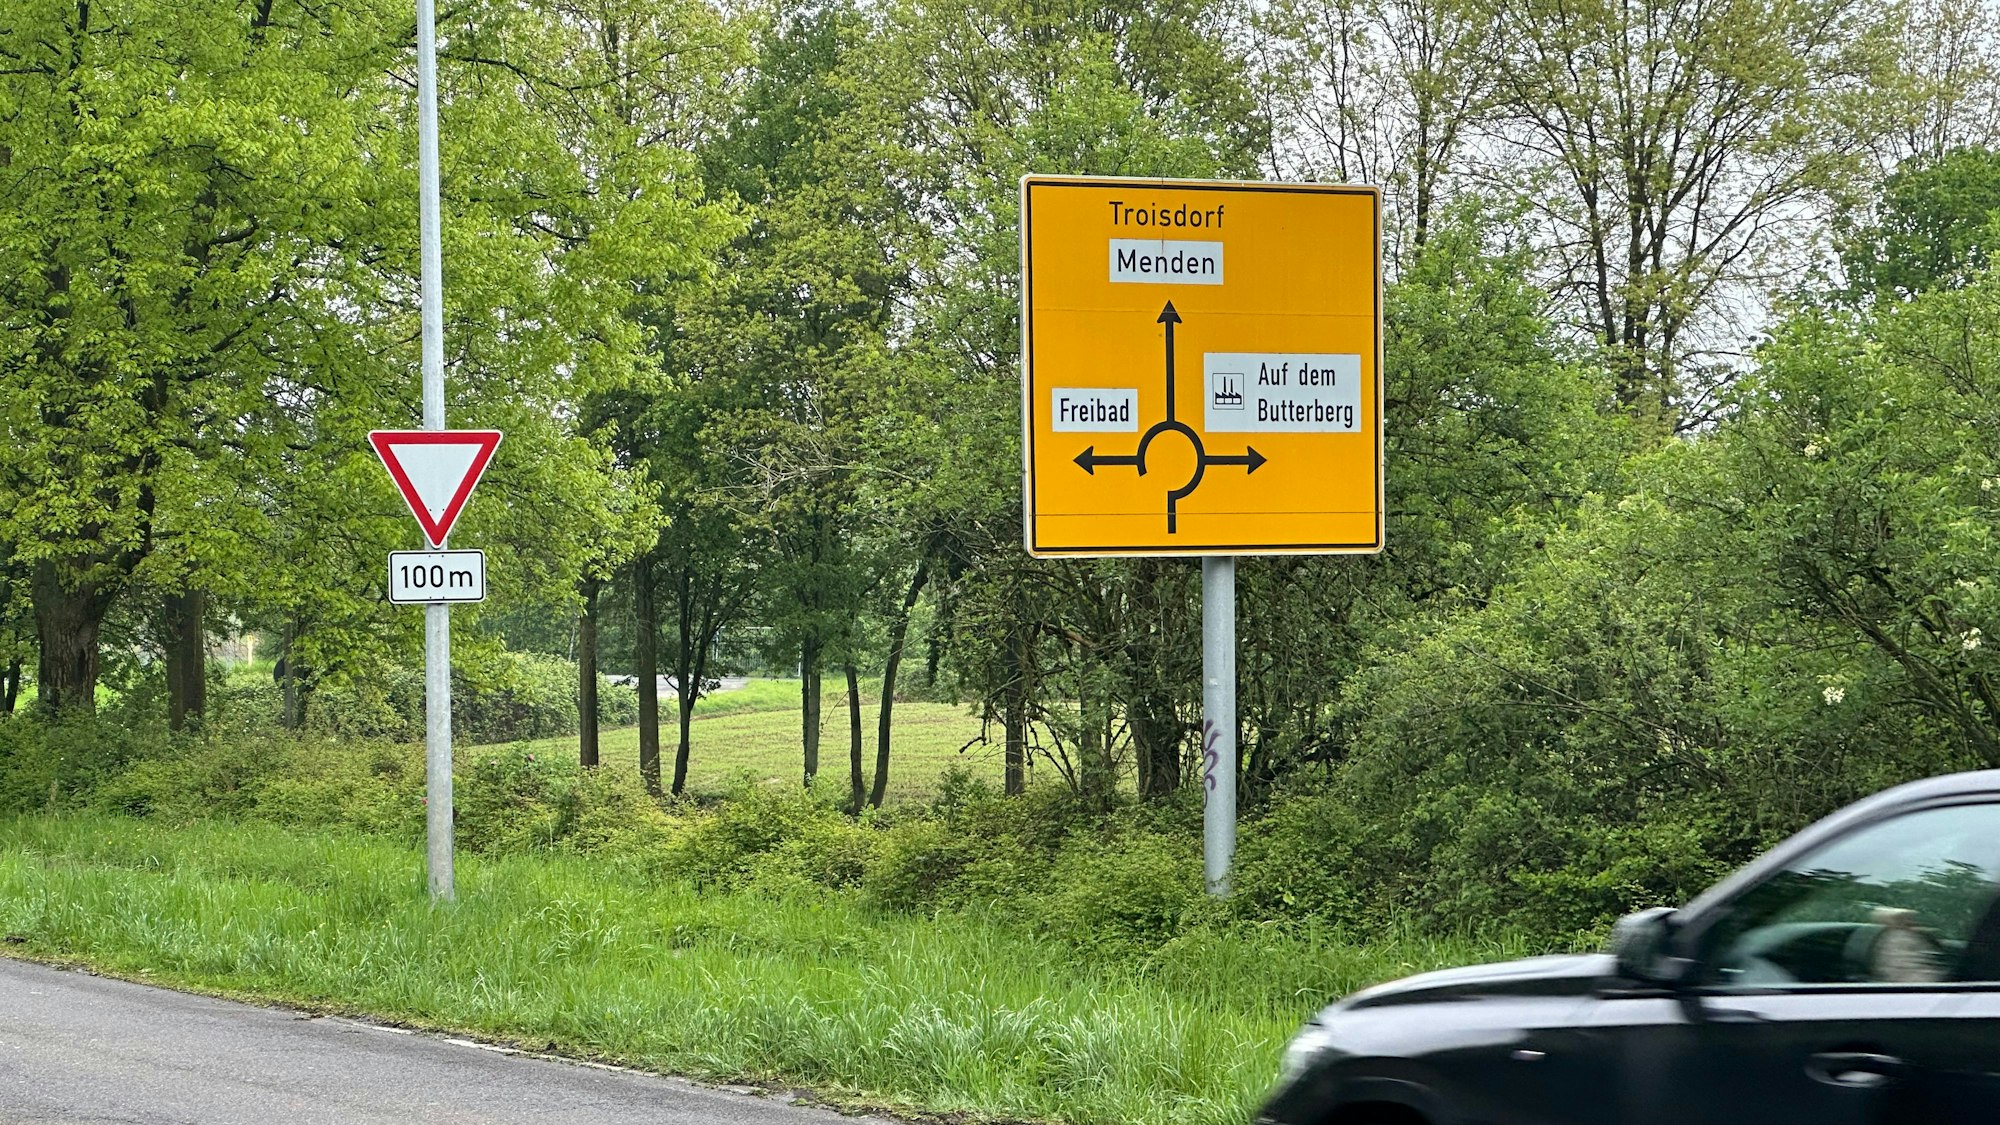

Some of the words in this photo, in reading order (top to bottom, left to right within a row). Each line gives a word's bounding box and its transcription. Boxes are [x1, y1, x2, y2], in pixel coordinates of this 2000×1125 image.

[1109, 202, 1224, 228] Troisdorf
[1118, 249, 1214, 274] Menden
[1259, 362, 1288, 385] Auf
[1300, 363, 1335, 385] dem
[1061, 398, 1128, 422] Freibad
[1259, 399, 1352, 428] Butterberg
